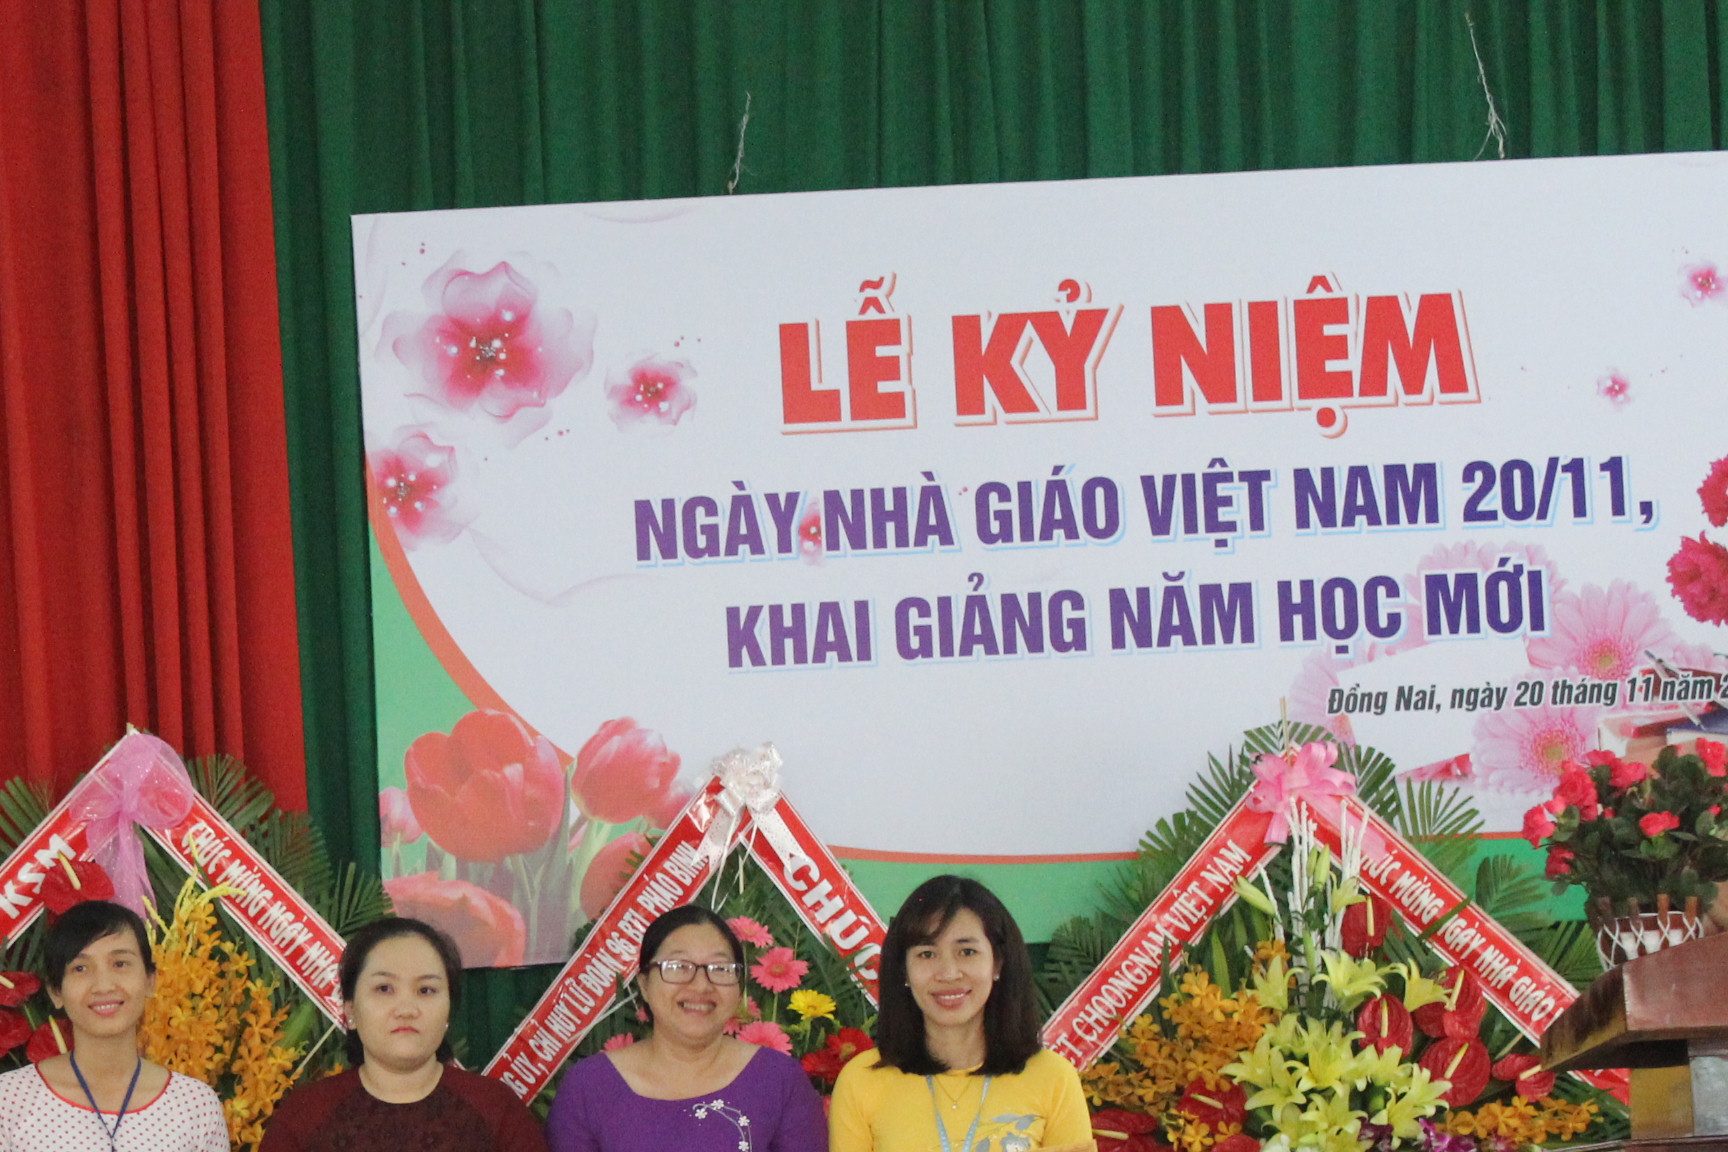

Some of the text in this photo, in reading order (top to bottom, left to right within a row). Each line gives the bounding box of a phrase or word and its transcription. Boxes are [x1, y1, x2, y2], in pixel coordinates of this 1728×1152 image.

[778, 274, 1472, 430] LỄ KỶ NIỆM
[633, 455, 1655, 563] NGÀY NHÀ GIÁO VIỆT NAM 20/11,
[725, 556, 1546, 669] KHAI GIẢNG NĂM HỌC MỚI
[1327, 680, 1388, 716] Đồng
[1394, 684, 1442, 715] Nai,
[1449, 682, 1509, 713] ngày
[1513, 679, 1545, 707] 20
[1551, 676, 1618, 708] tháng
[1626, 675, 1654, 702] 11
[1660, 672, 1714, 702] năm
[181, 820, 232, 876] CHÚC
[256, 900, 314, 957] NGÀY
[783, 853, 882, 980] CHÚC
[1071, 922, 1181, 1043] CHOONGNAM
[1165, 887, 1215, 934] VIỆT
[1200, 838, 1254, 894] NAM
[1388, 870, 1445, 925] MỪNG
[1473, 944, 1522, 990] NHÀ
[1508, 975, 1556, 1022] GIÁO
[544, 995, 583, 1043] HUY
[577, 946, 628, 1000] ĐOÀN
[605, 930, 639, 963] 96
[636, 872, 686, 917] PHÁO
